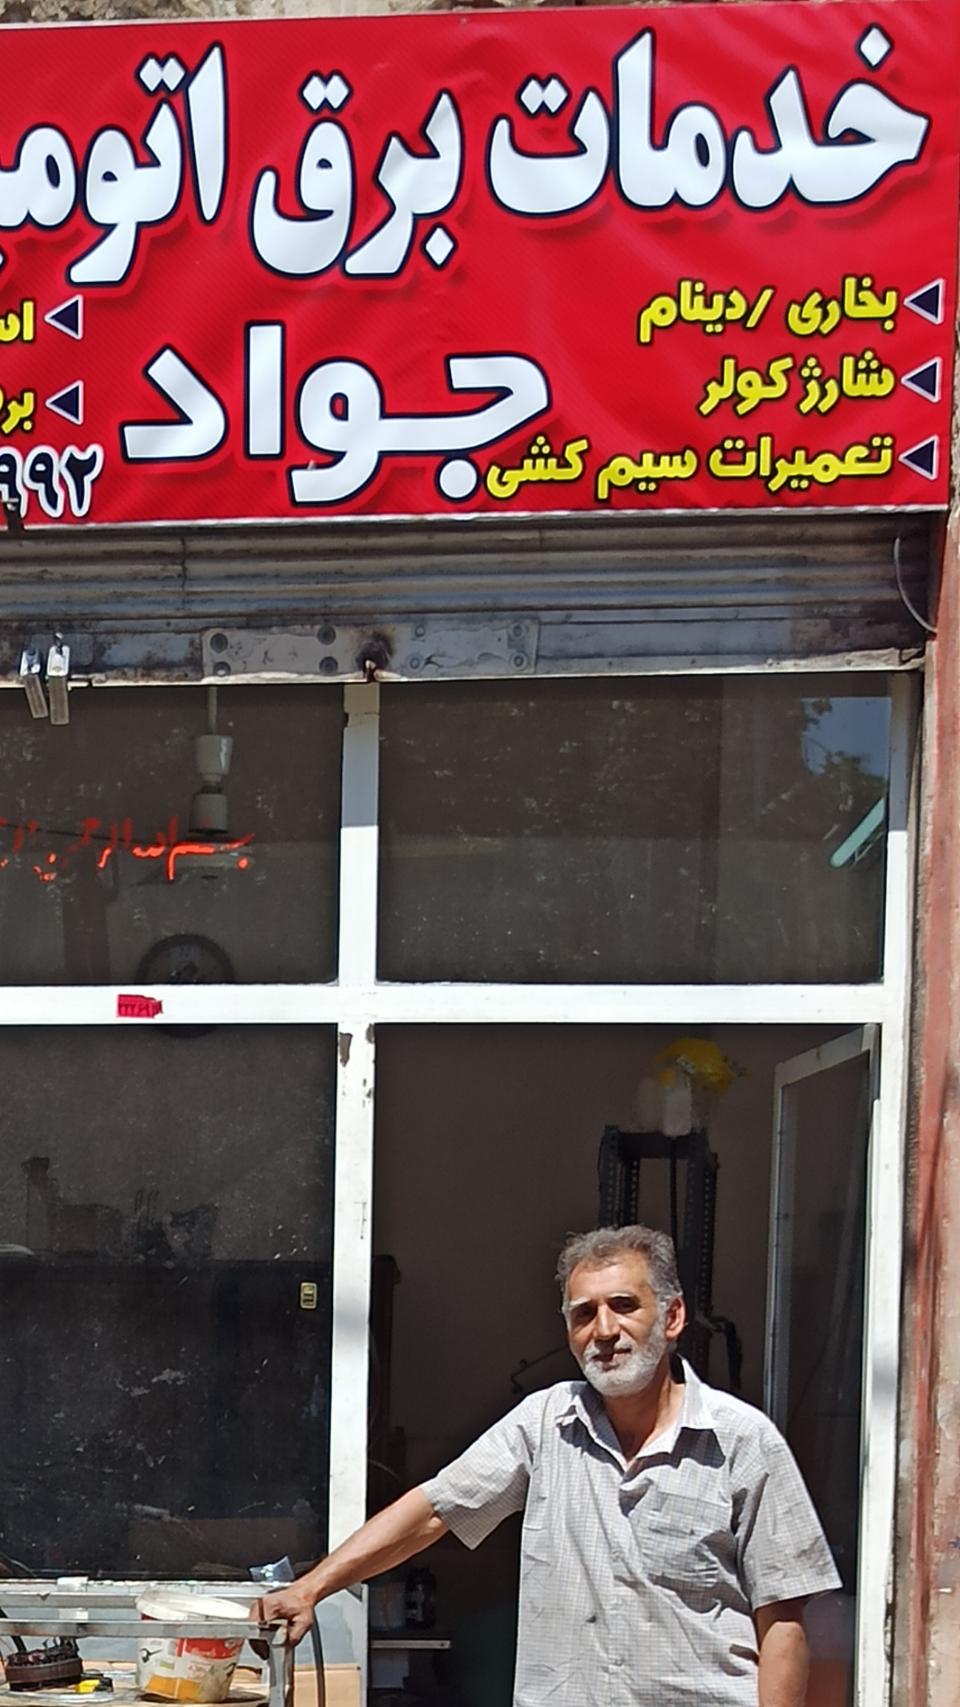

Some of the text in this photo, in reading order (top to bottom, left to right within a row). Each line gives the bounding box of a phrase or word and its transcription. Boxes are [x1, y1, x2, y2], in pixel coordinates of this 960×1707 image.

[252, 74, 462, 275] برق
[488, 26, 929, 214] خدمات
[786, 276, 898, 336] بخاری
[122, 324, 550, 503] جواد
[698, 354, 896, 416] شارژ کولر
[486, 435, 893, 500] تعمیرات سیم کشی
